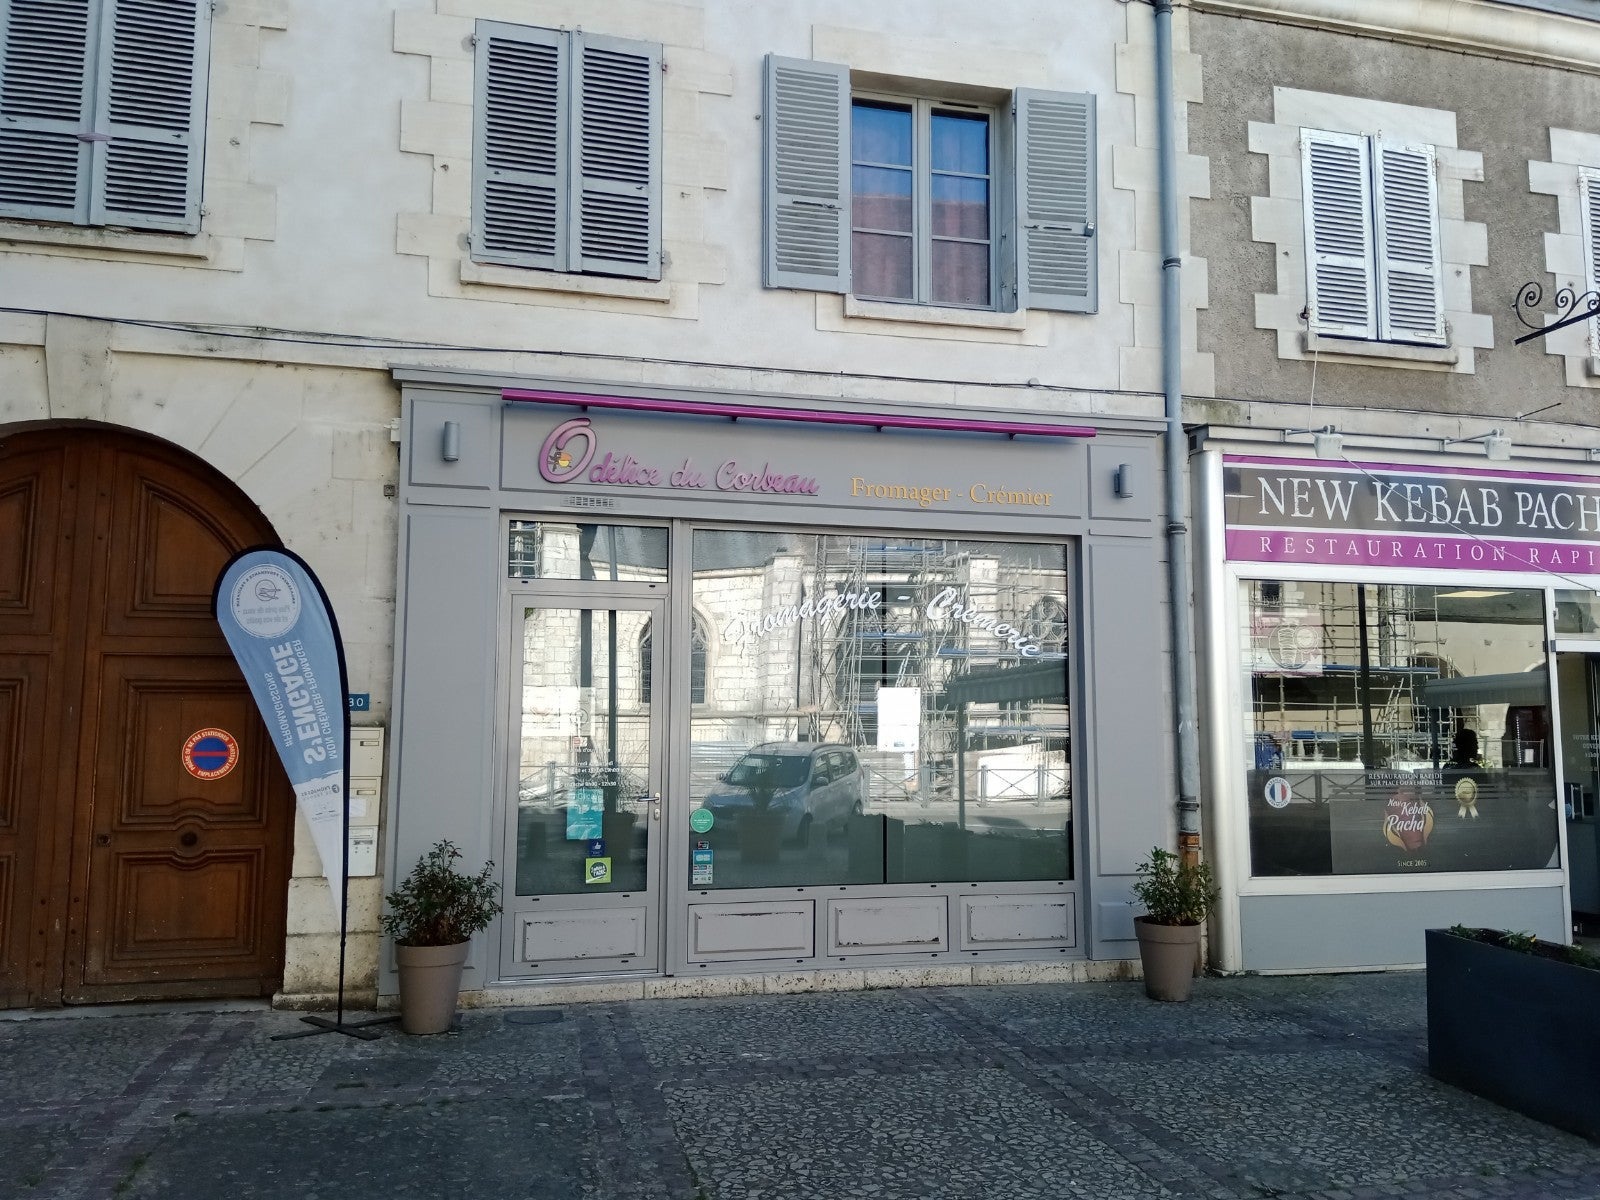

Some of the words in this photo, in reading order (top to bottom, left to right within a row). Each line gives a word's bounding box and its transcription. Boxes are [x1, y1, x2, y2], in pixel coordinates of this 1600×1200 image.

[669, 457, 707, 488] du
[716, 459, 820, 494] Corbeau
[851, 476, 951, 507] Fromager
[970, 483, 1052, 506] Crémier
[1257, 476, 1358, 522] NEW
[1373, 481, 1503, 527] KEBAB
[1514, 491, 1600, 532] PACH
[1259, 536, 1505, 562] RESTAURATION
[1529, 547, 1595, 566] RAPI
[1387, 814, 1425, 832] Pacha
[1401, 801, 1429, 816] Kebab
